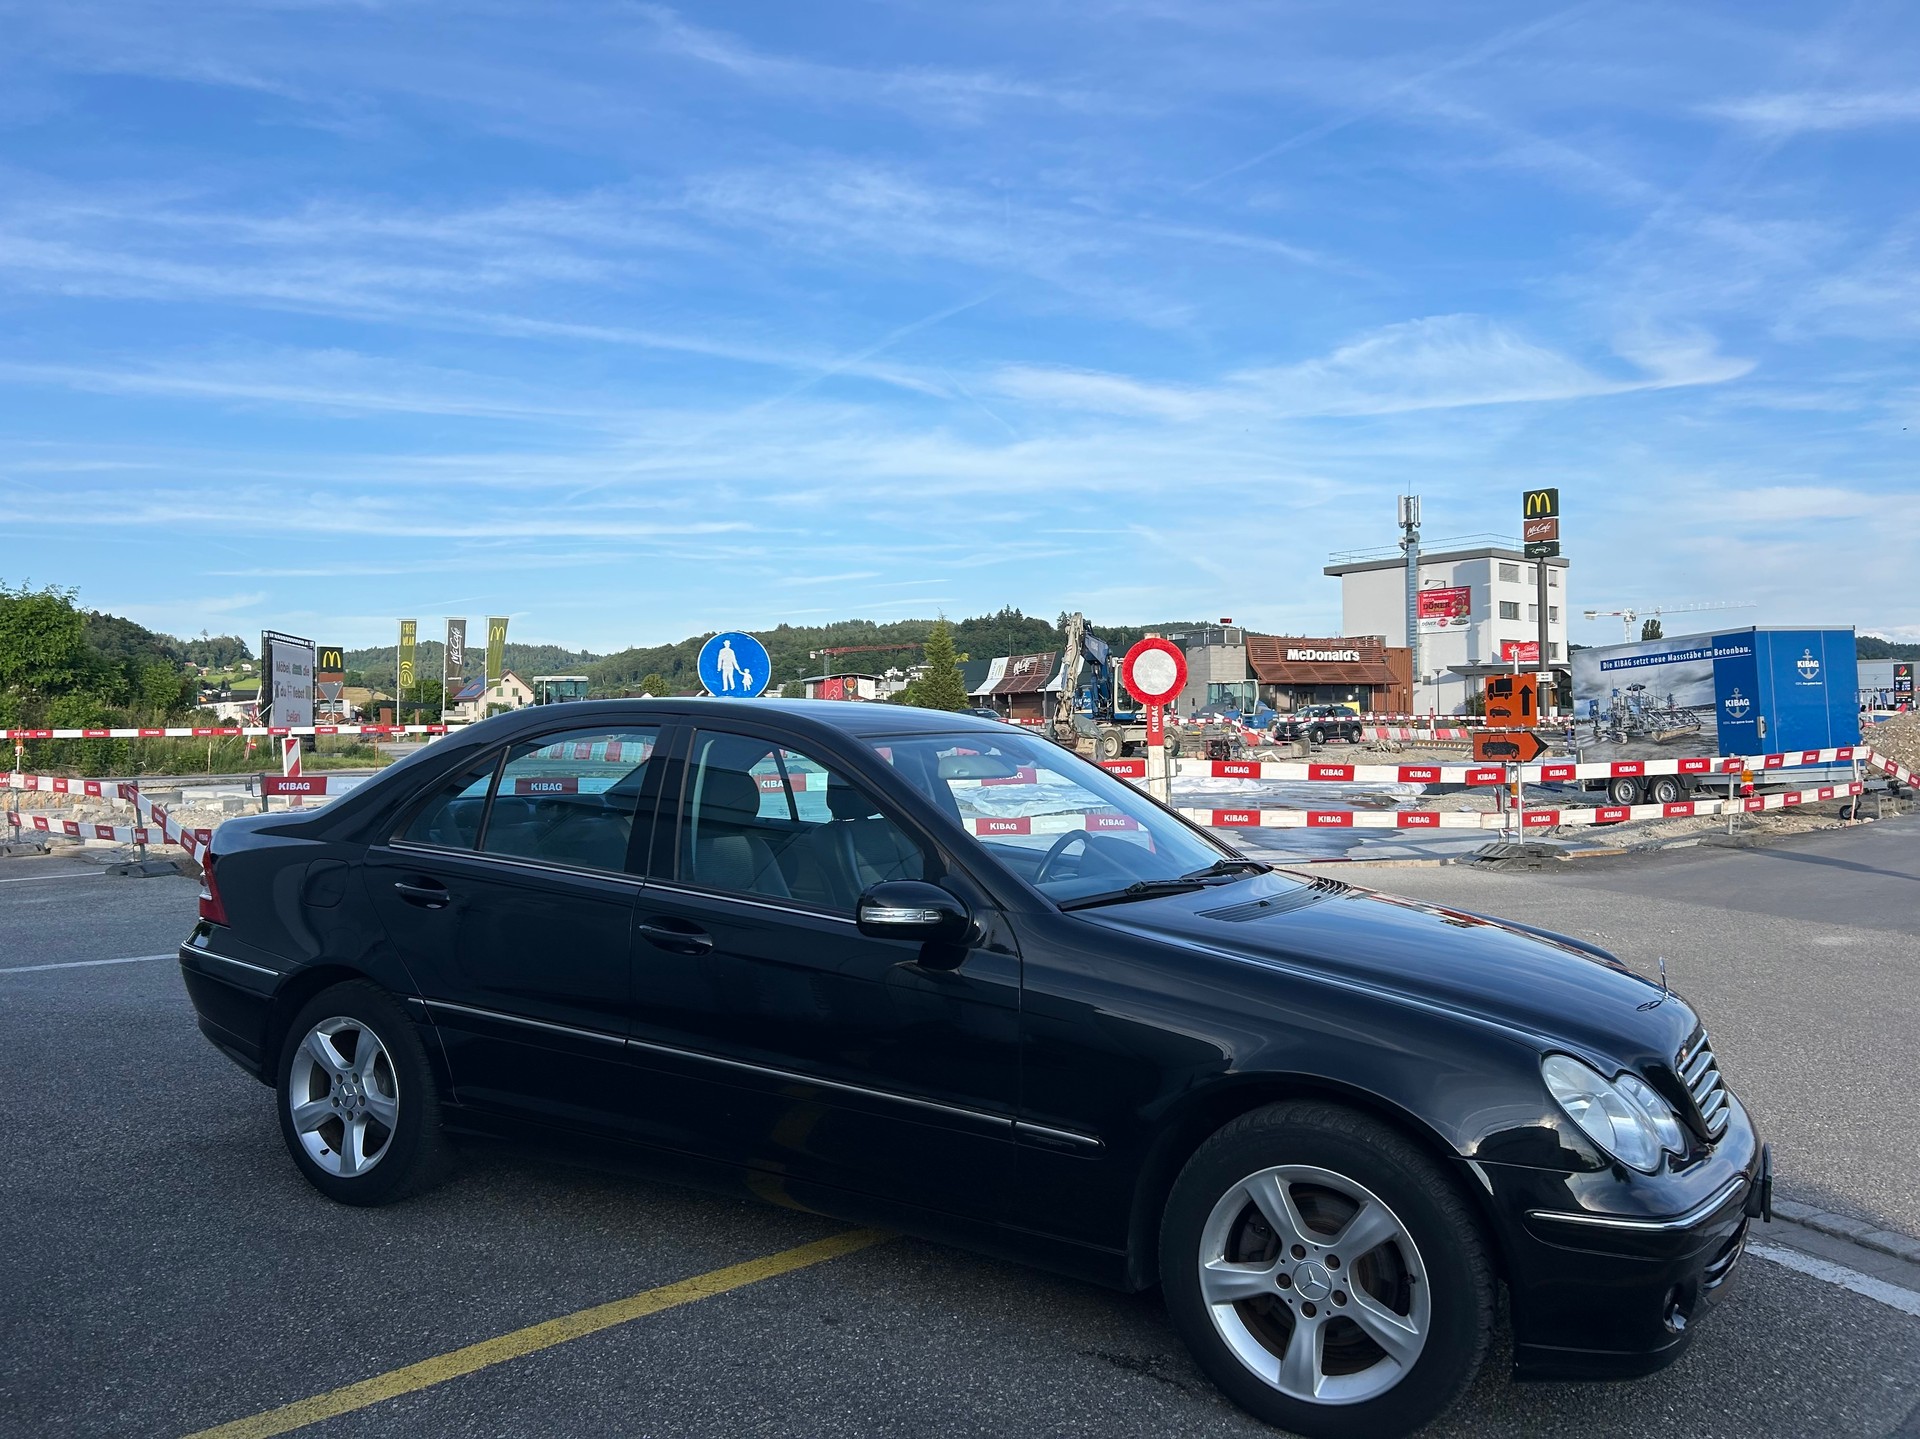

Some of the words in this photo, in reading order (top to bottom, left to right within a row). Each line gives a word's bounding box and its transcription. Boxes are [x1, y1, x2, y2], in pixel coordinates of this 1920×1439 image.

[1286, 648, 1361, 662] McDonald's
[1602, 661, 1613, 670] Die
[1614, 659, 1632, 669] KIBAG
[1633, 657, 1649, 667] setzt
[1650, 656, 1666, 664] neue
[1667, 651, 1702, 662] Massstäbe
[1703, 649, 1712, 657] im
[1713, 645, 1752, 657] Betonbau.
[1797, 660, 1820, 668] KIBAG
[1725, 698, 1750, 708] KIBAG
[1151, 705, 1160, 733] KIBAG
[1224, 765, 1250, 774] KIBAG
[1619, 765, 1637, 773] KIBAG
[1685, 761, 1704, 769] KIBAG
[1320, 768, 1344, 777] KIBAG
[1409, 770, 1432, 778] KIBAG
[1477, 773, 1497, 781] KIBAG
[1549, 769, 1568, 777] KIBAG
[278, 782, 311, 791] KIBAG
[531, 782, 563, 791] KIBAG
[760, 780, 784, 788] KIBA
[1670, 805, 1688, 814] KIBAG
[1223, 814, 1249, 823] KIBAG
[1530, 815, 1551, 823] KIBAG
[1604, 810, 1623, 819] KIBAG
[1099, 818, 1126, 827] KIBAG
[1317, 815, 1342, 824] KIBAG
[1407, 816, 1430, 824] KIBAG
[989, 822, 1017, 831] KIBAG
